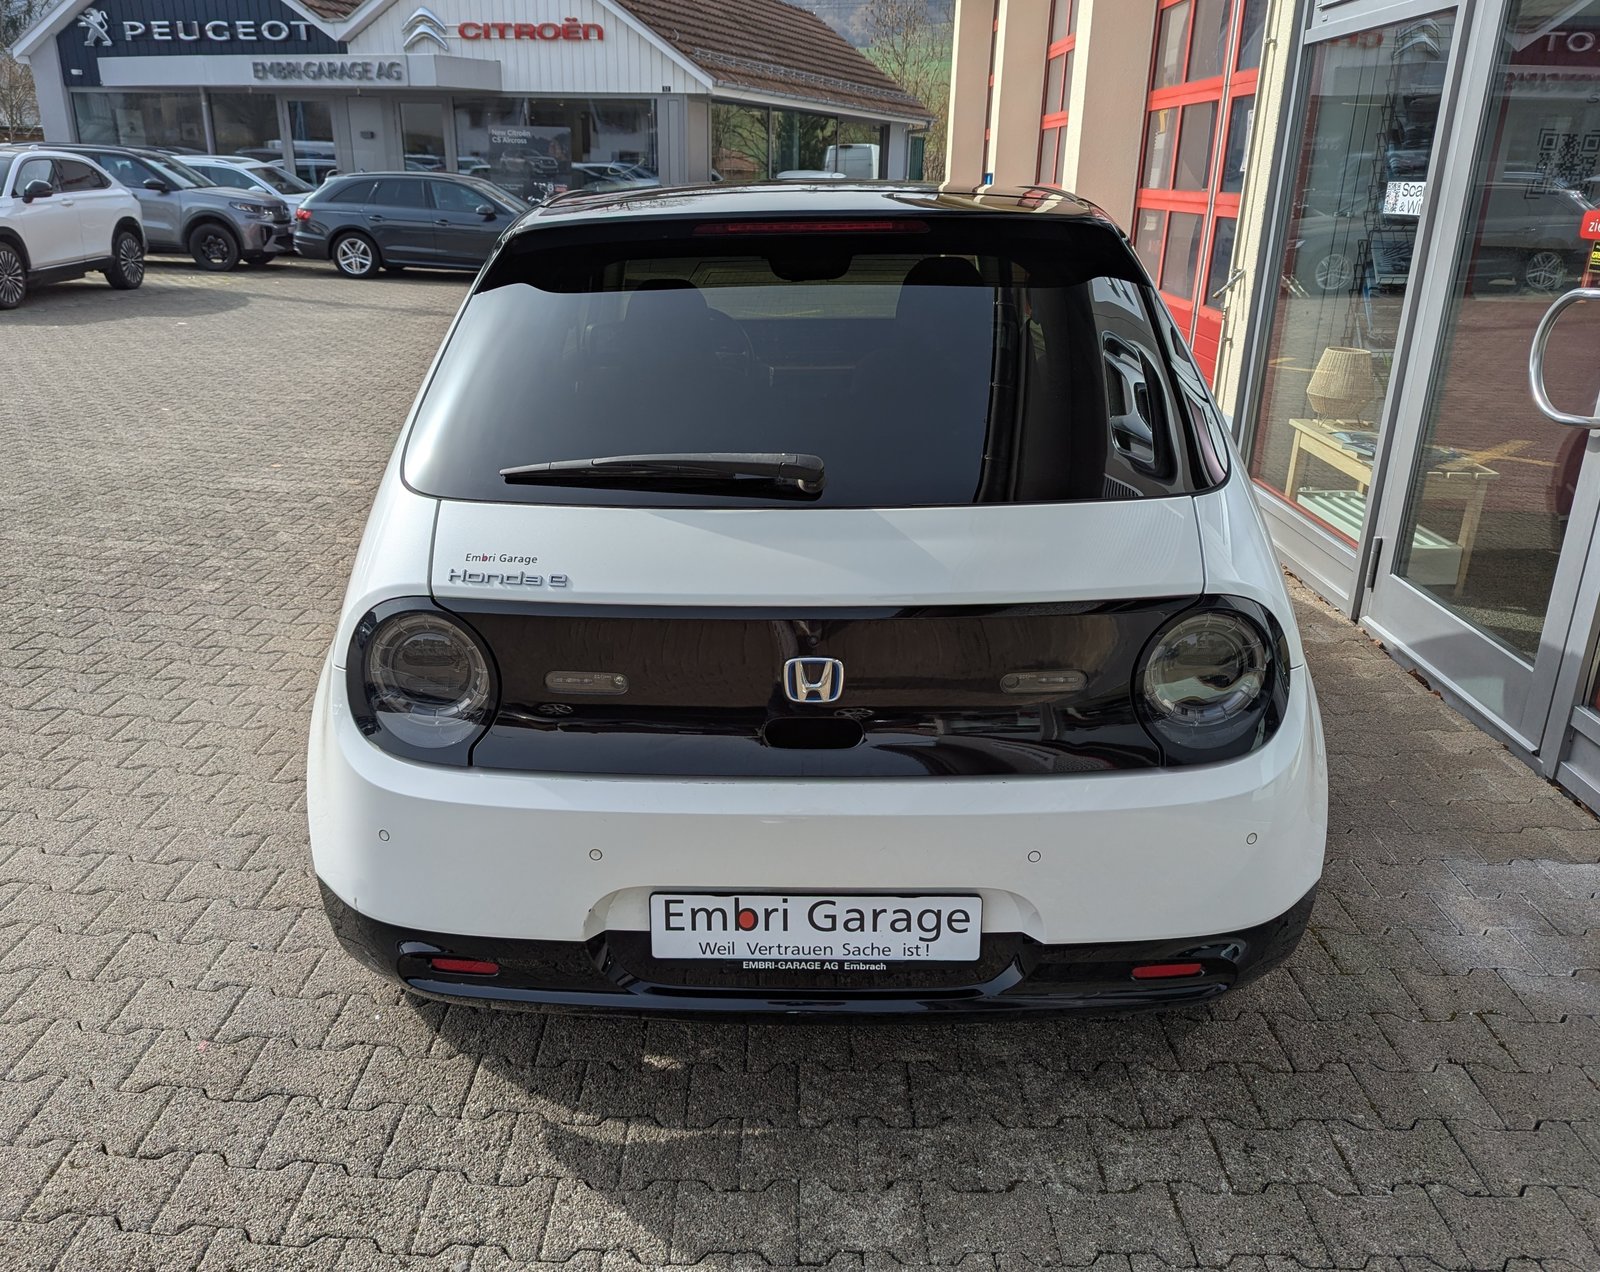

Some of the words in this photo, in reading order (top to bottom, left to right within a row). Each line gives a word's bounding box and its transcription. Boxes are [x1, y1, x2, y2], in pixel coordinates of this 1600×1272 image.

[122, 20, 312, 42] PEUGEOT
[375, 61, 403, 81] AG
[1402, 182, 1426, 198] Sca
[1407, 198, 1422, 214] Wi
[465, 553, 496, 562] Embri
[499, 553, 538, 566] Garage
[447, 568, 544, 587] Honda
[663, 897, 789, 933] Embri
[807, 899, 971, 943] Garage
[698, 941, 736, 956] Weil
[746, 942, 834, 957] Vertrauen
[842, 942, 892, 957] Sache
[742, 961, 822, 971] EMBRI-GARAGE
[823, 961, 839, 971] AG
[843, 961, 887, 972] Embrach
